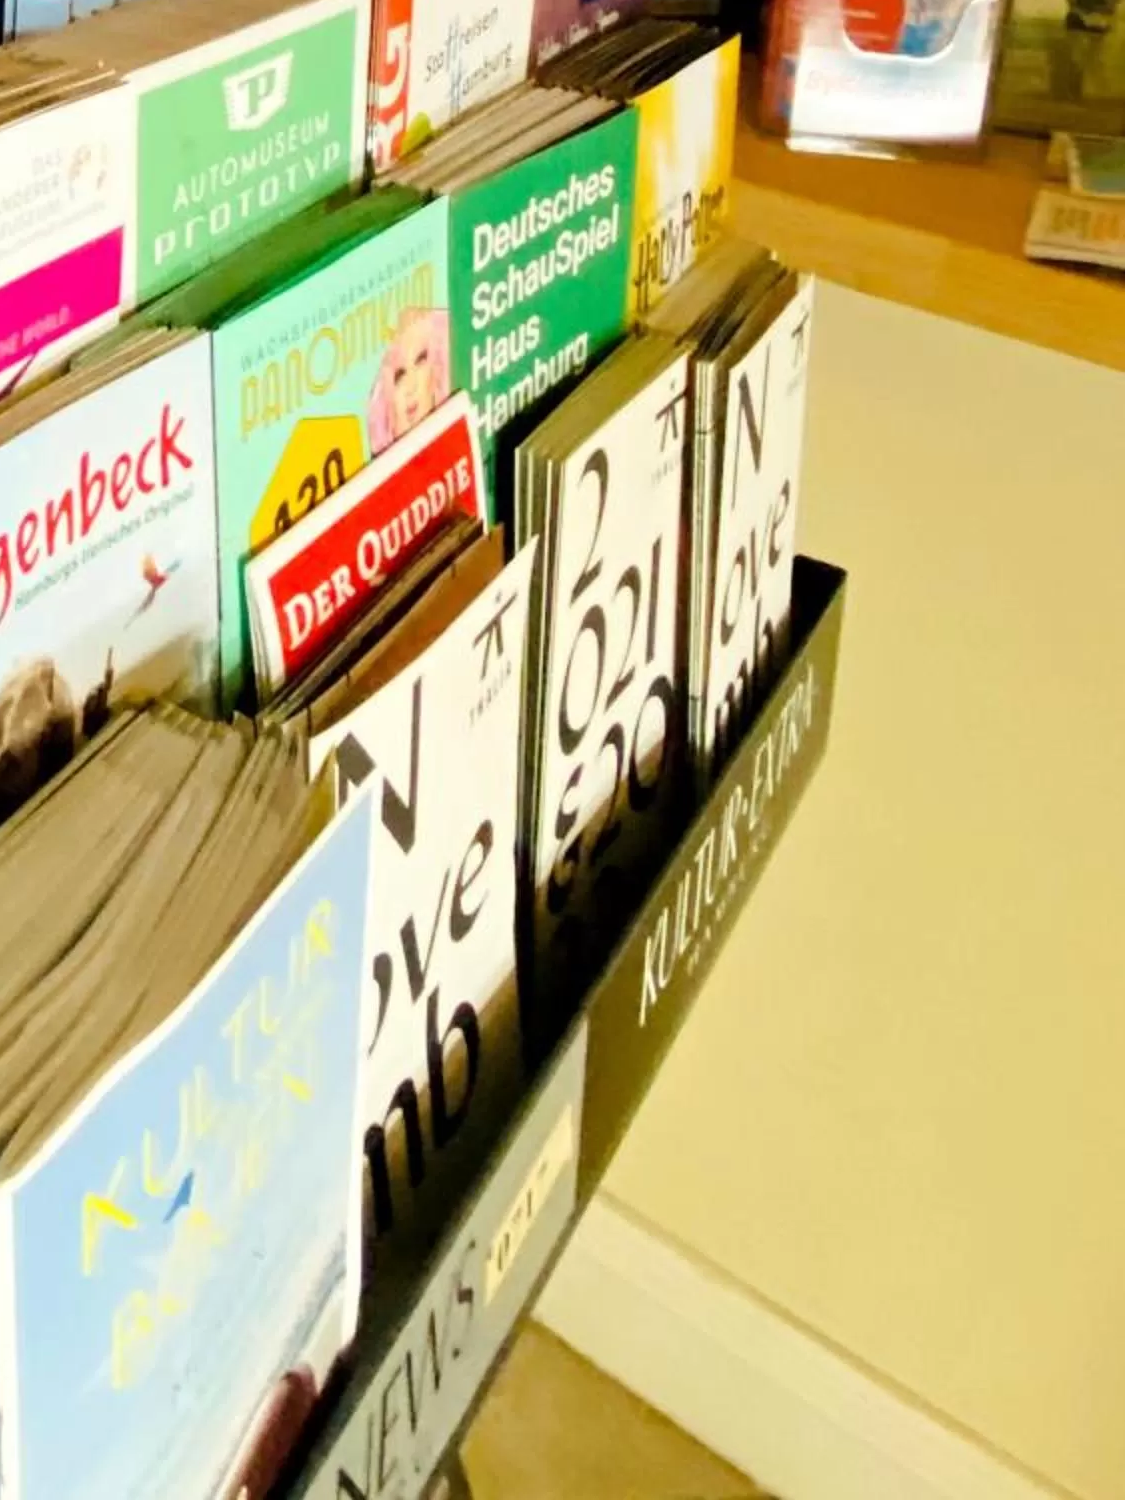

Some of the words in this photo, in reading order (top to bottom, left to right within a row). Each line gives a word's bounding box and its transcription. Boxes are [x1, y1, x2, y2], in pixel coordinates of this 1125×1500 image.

[172, 111, 331, 213] AUTOMUSEUM
[473, 163, 616, 274] Deutsches
[471, 202, 619, 331] SchauSpiel
[471, 314, 541, 392] Haus
[473, 331, 589, 440] Hamburg
[731, 341, 771, 511] N
[570, 447, 609, 610] 2
[283, 564, 357, 651] DER
[558, 532, 663, 757] 021
[336, 677, 422, 857] N
[81, 897, 335, 1278] KULTUR
